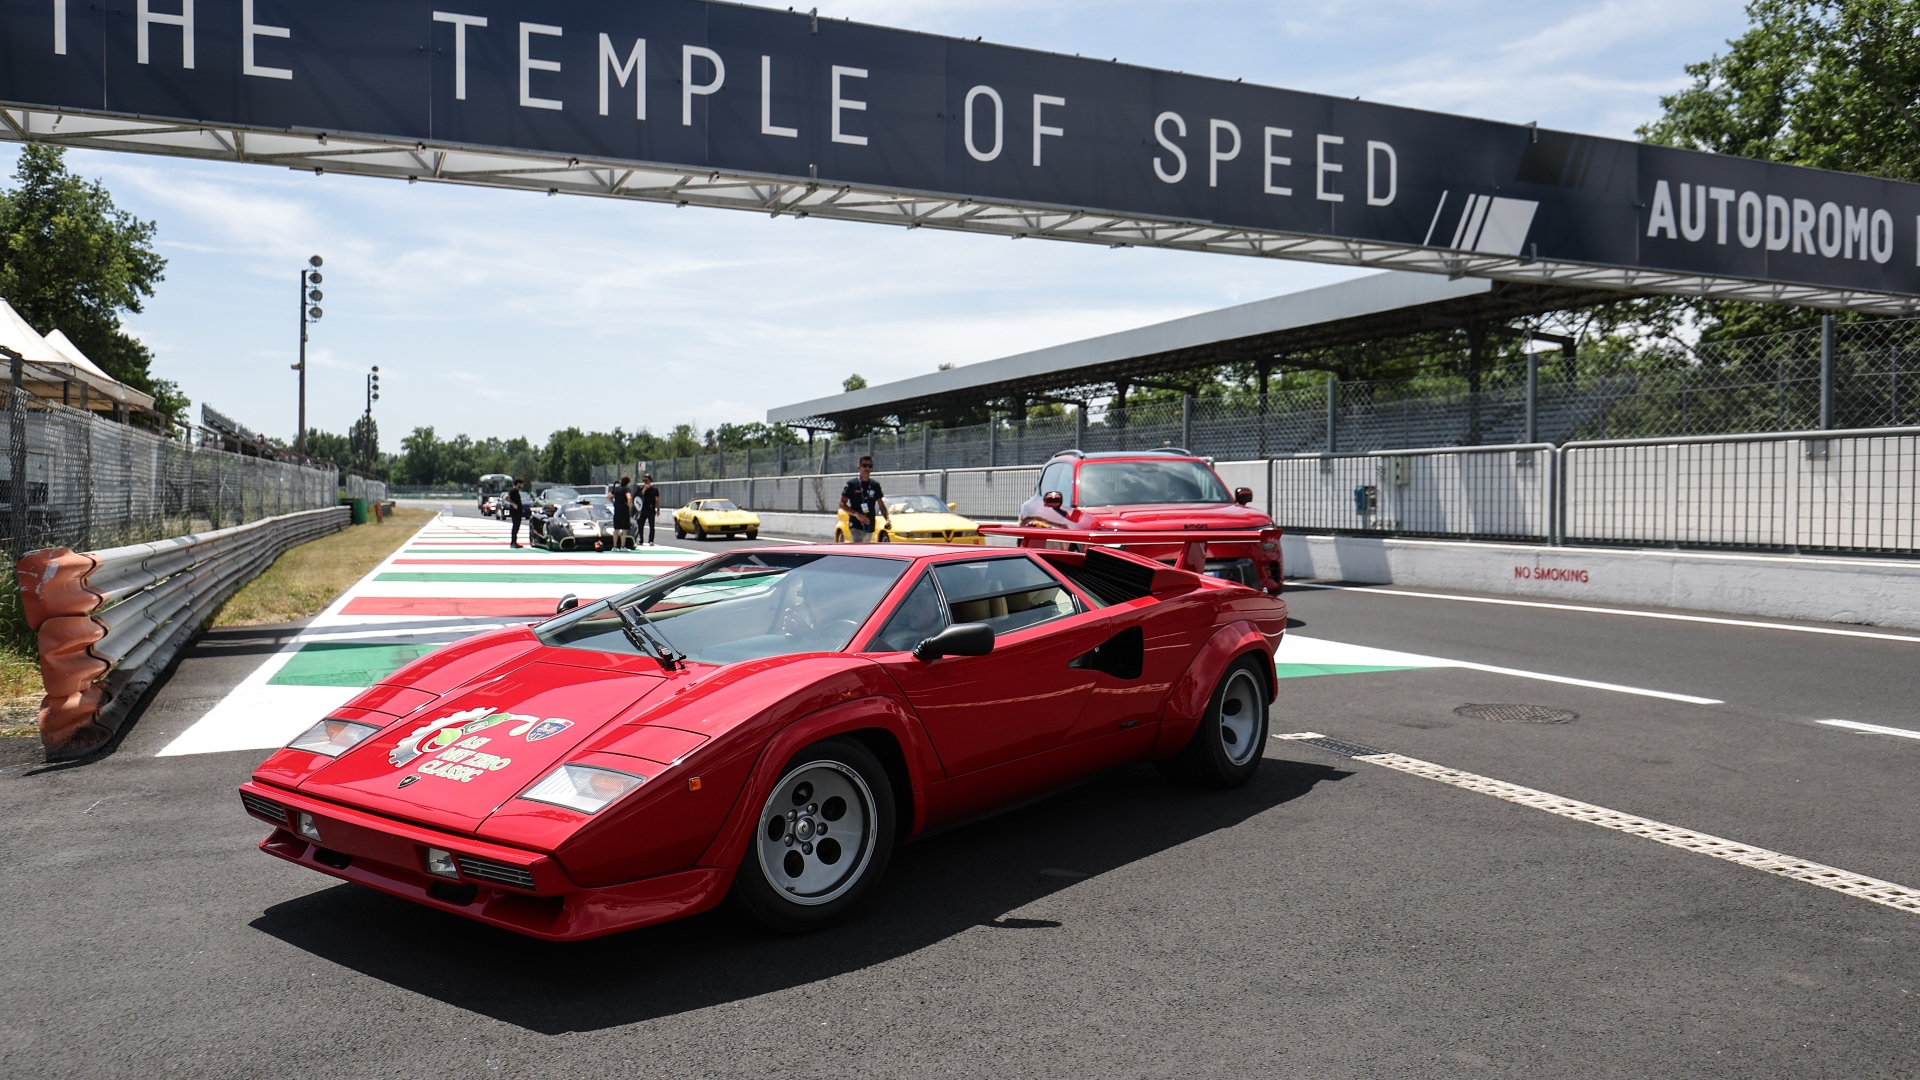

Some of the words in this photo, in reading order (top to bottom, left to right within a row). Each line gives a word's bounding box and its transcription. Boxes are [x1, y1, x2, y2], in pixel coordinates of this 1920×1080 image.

[433, 11, 868, 146] TEMPLE
[964, 85, 1065, 167] OF
[1153, 111, 1398, 207] SPEED
[1646, 179, 1894, 264] AUTODROMO
[1514, 566, 1530, 579] NO
[1534, 566, 1589, 583] SMOKING
[454, 735, 492, 750] ASI
[417, 759, 484, 783] CLASSIC
[435, 747, 478, 763] NET
[461, 752, 512, 771] ZERO
